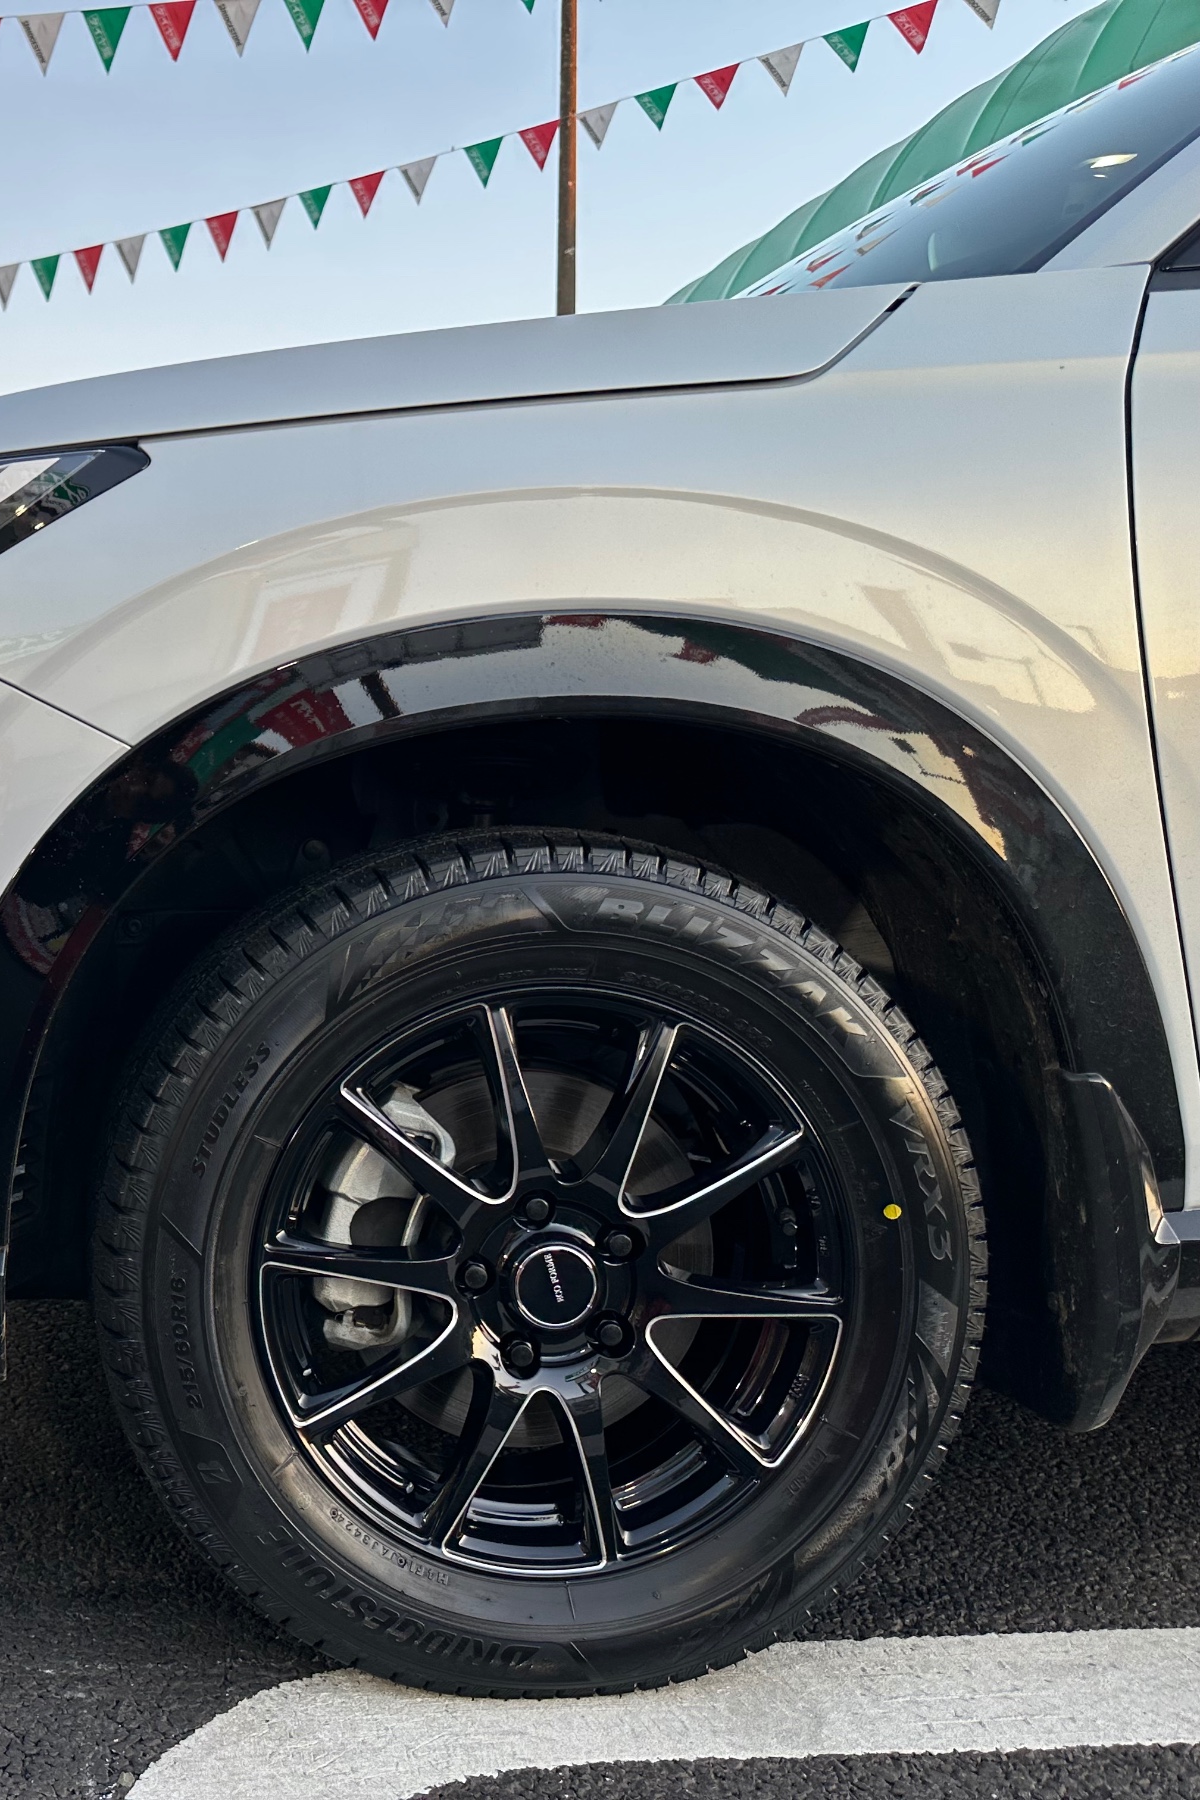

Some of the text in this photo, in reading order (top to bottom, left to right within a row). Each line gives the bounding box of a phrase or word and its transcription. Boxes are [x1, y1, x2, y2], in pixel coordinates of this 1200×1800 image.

[191, 1040, 271, 1179] STUDLESS
[597, 897, 953, 1262] BLIZZAK VRX3
[257, 1525, 541, 1669] BRIDGESTONE
